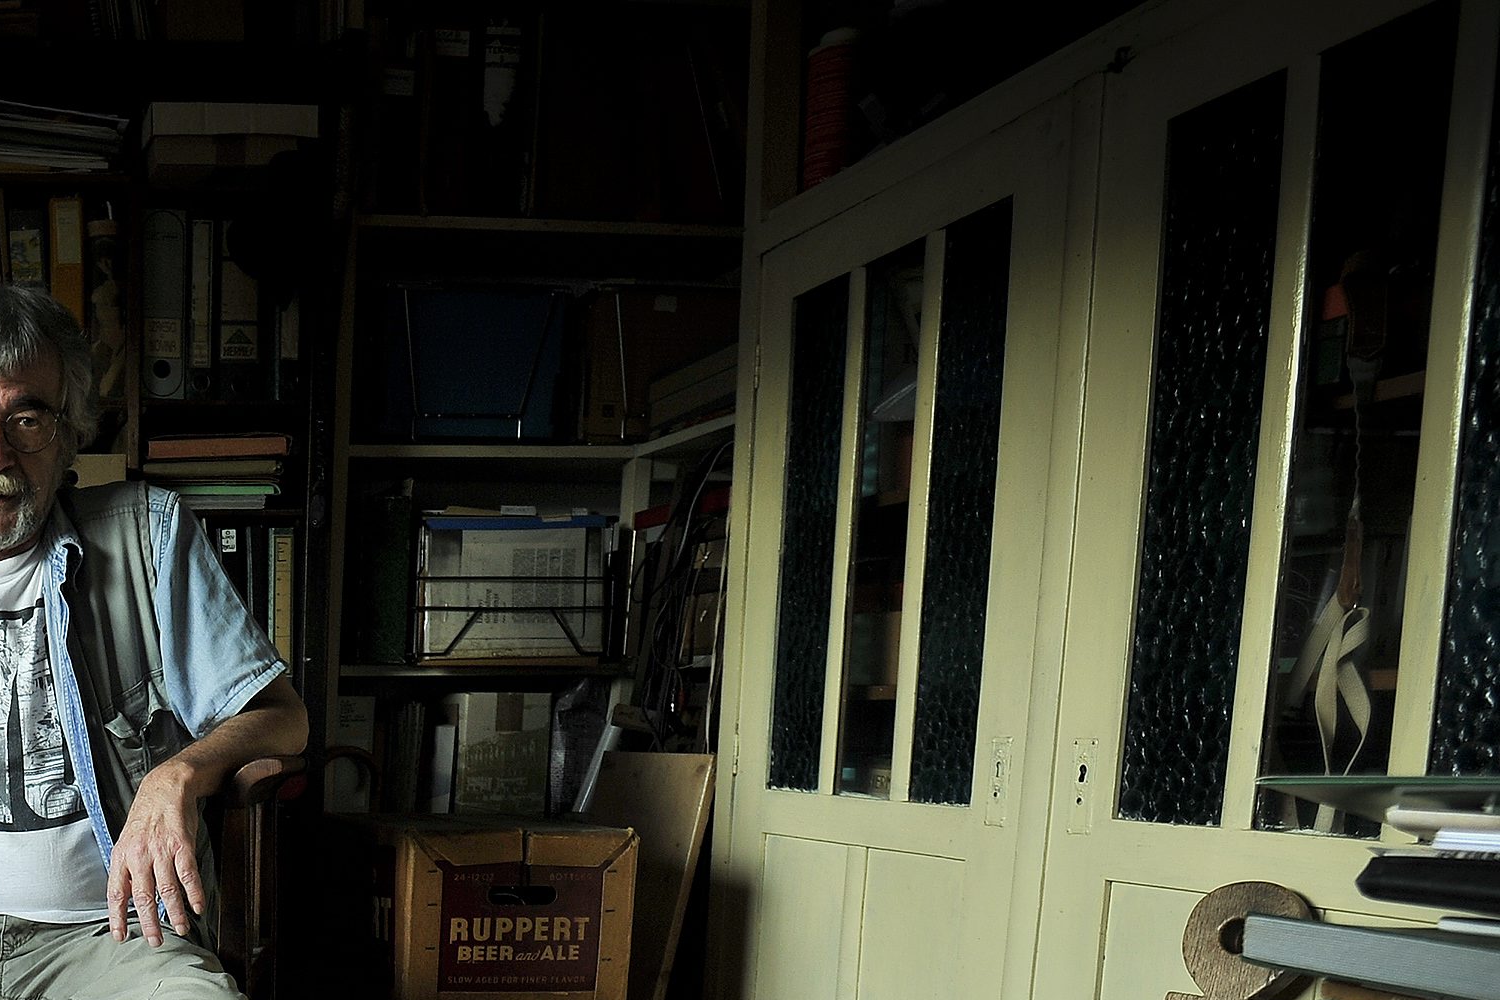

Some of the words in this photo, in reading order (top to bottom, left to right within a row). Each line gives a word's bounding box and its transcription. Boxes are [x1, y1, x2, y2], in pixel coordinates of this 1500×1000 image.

[449, 915, 591, 944] RUPPERT
[456, 945, 514, 964] BEER
[515, 948, 540, 962] and
[540, 944, 580, 961] ALE
[447, 975, 473, 984] SLOW
[474, 975, 499, 985] AGED
[501, 975, 518, 985] FOR
[521, 975, 547, 985] FINER
